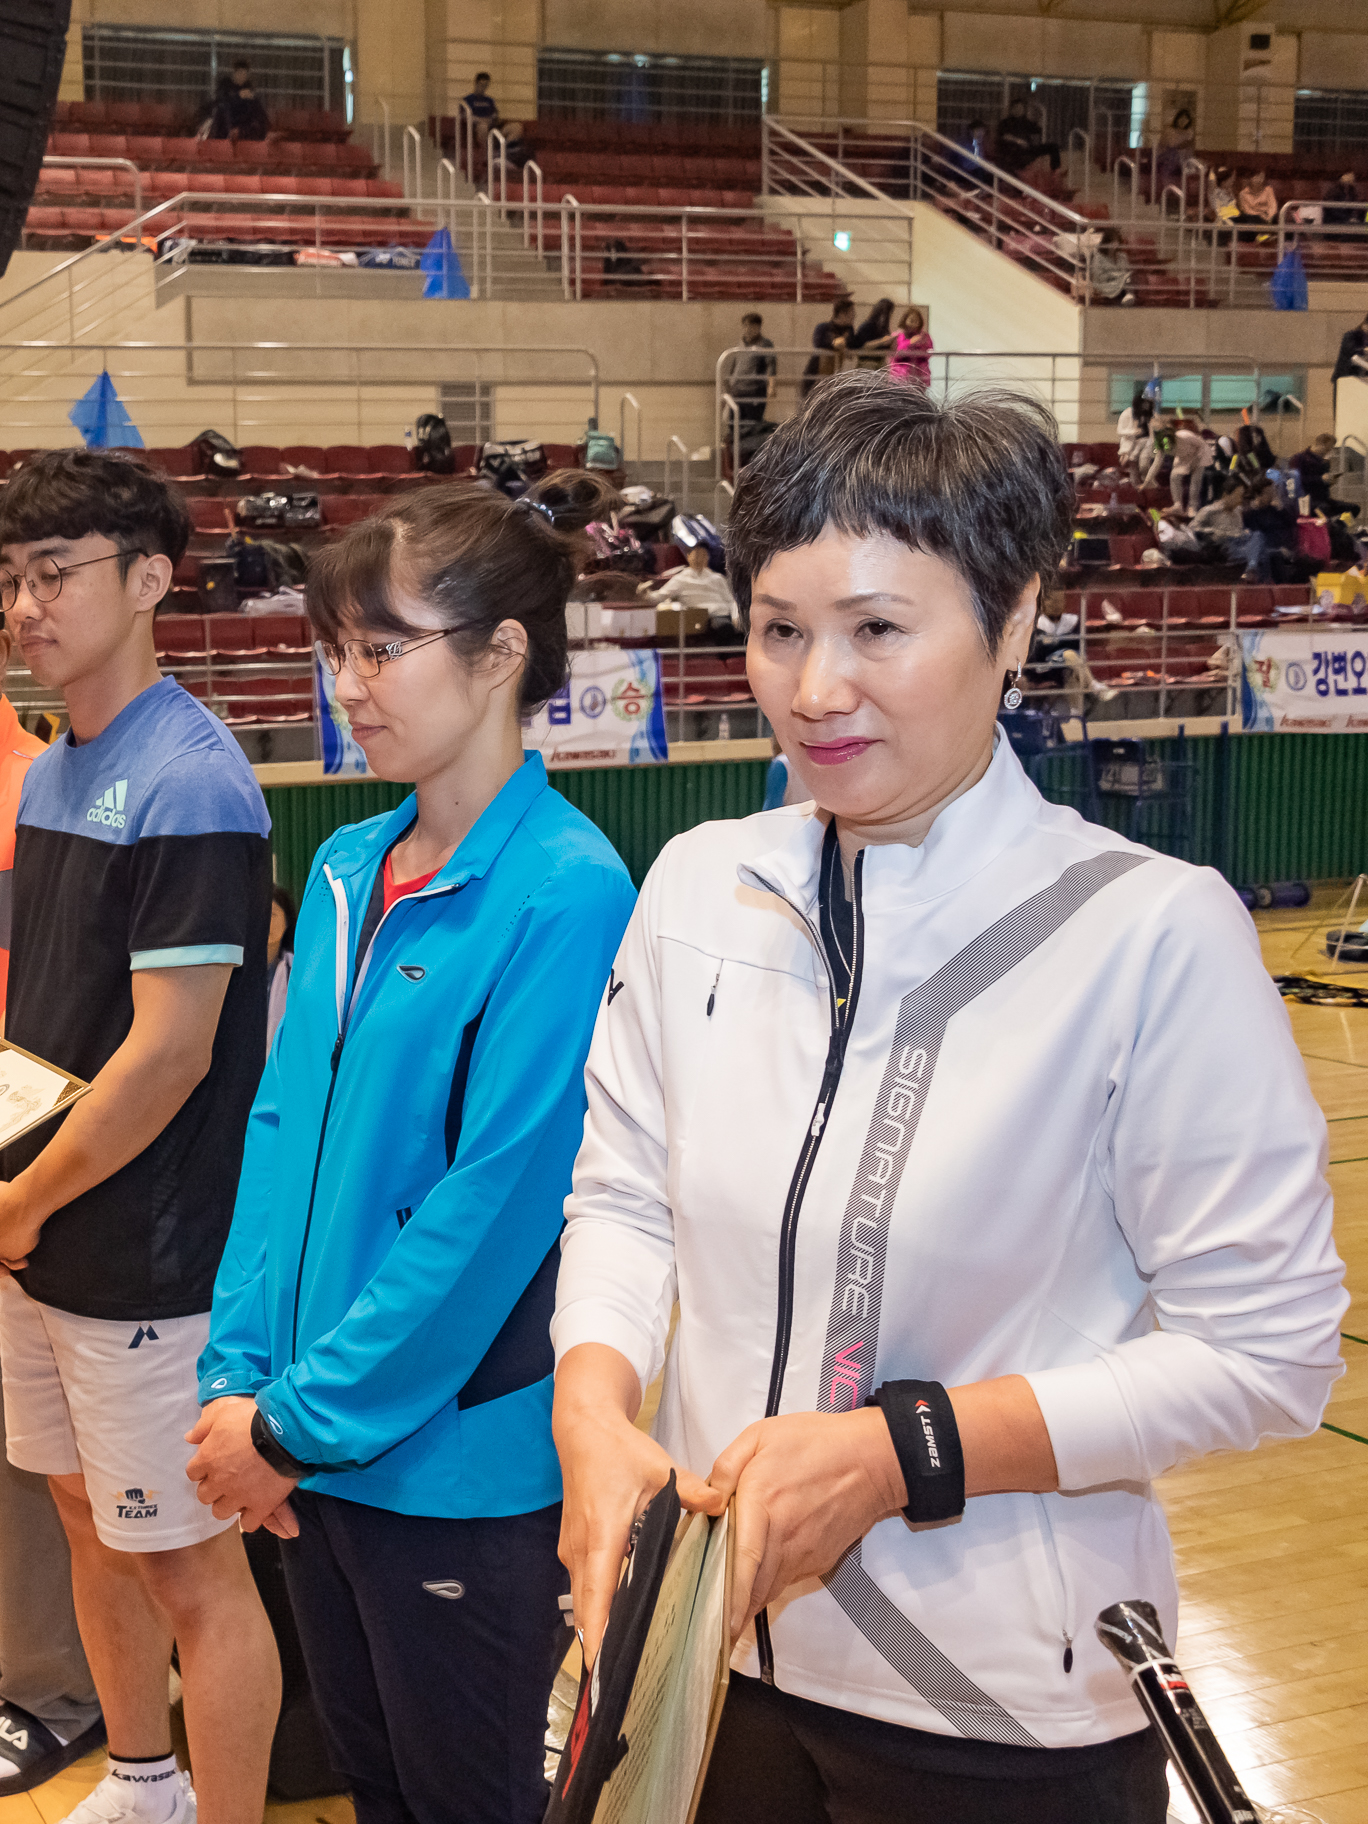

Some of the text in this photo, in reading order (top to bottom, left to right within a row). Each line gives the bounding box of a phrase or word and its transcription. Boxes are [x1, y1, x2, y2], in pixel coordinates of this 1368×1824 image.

[616, 681, 649, 716] 승
[86, 805, 127, 829] adidas
[841, 1045, 929, 1319] SIGNATURE
[116, 1505, 158, 1519] TEAM
